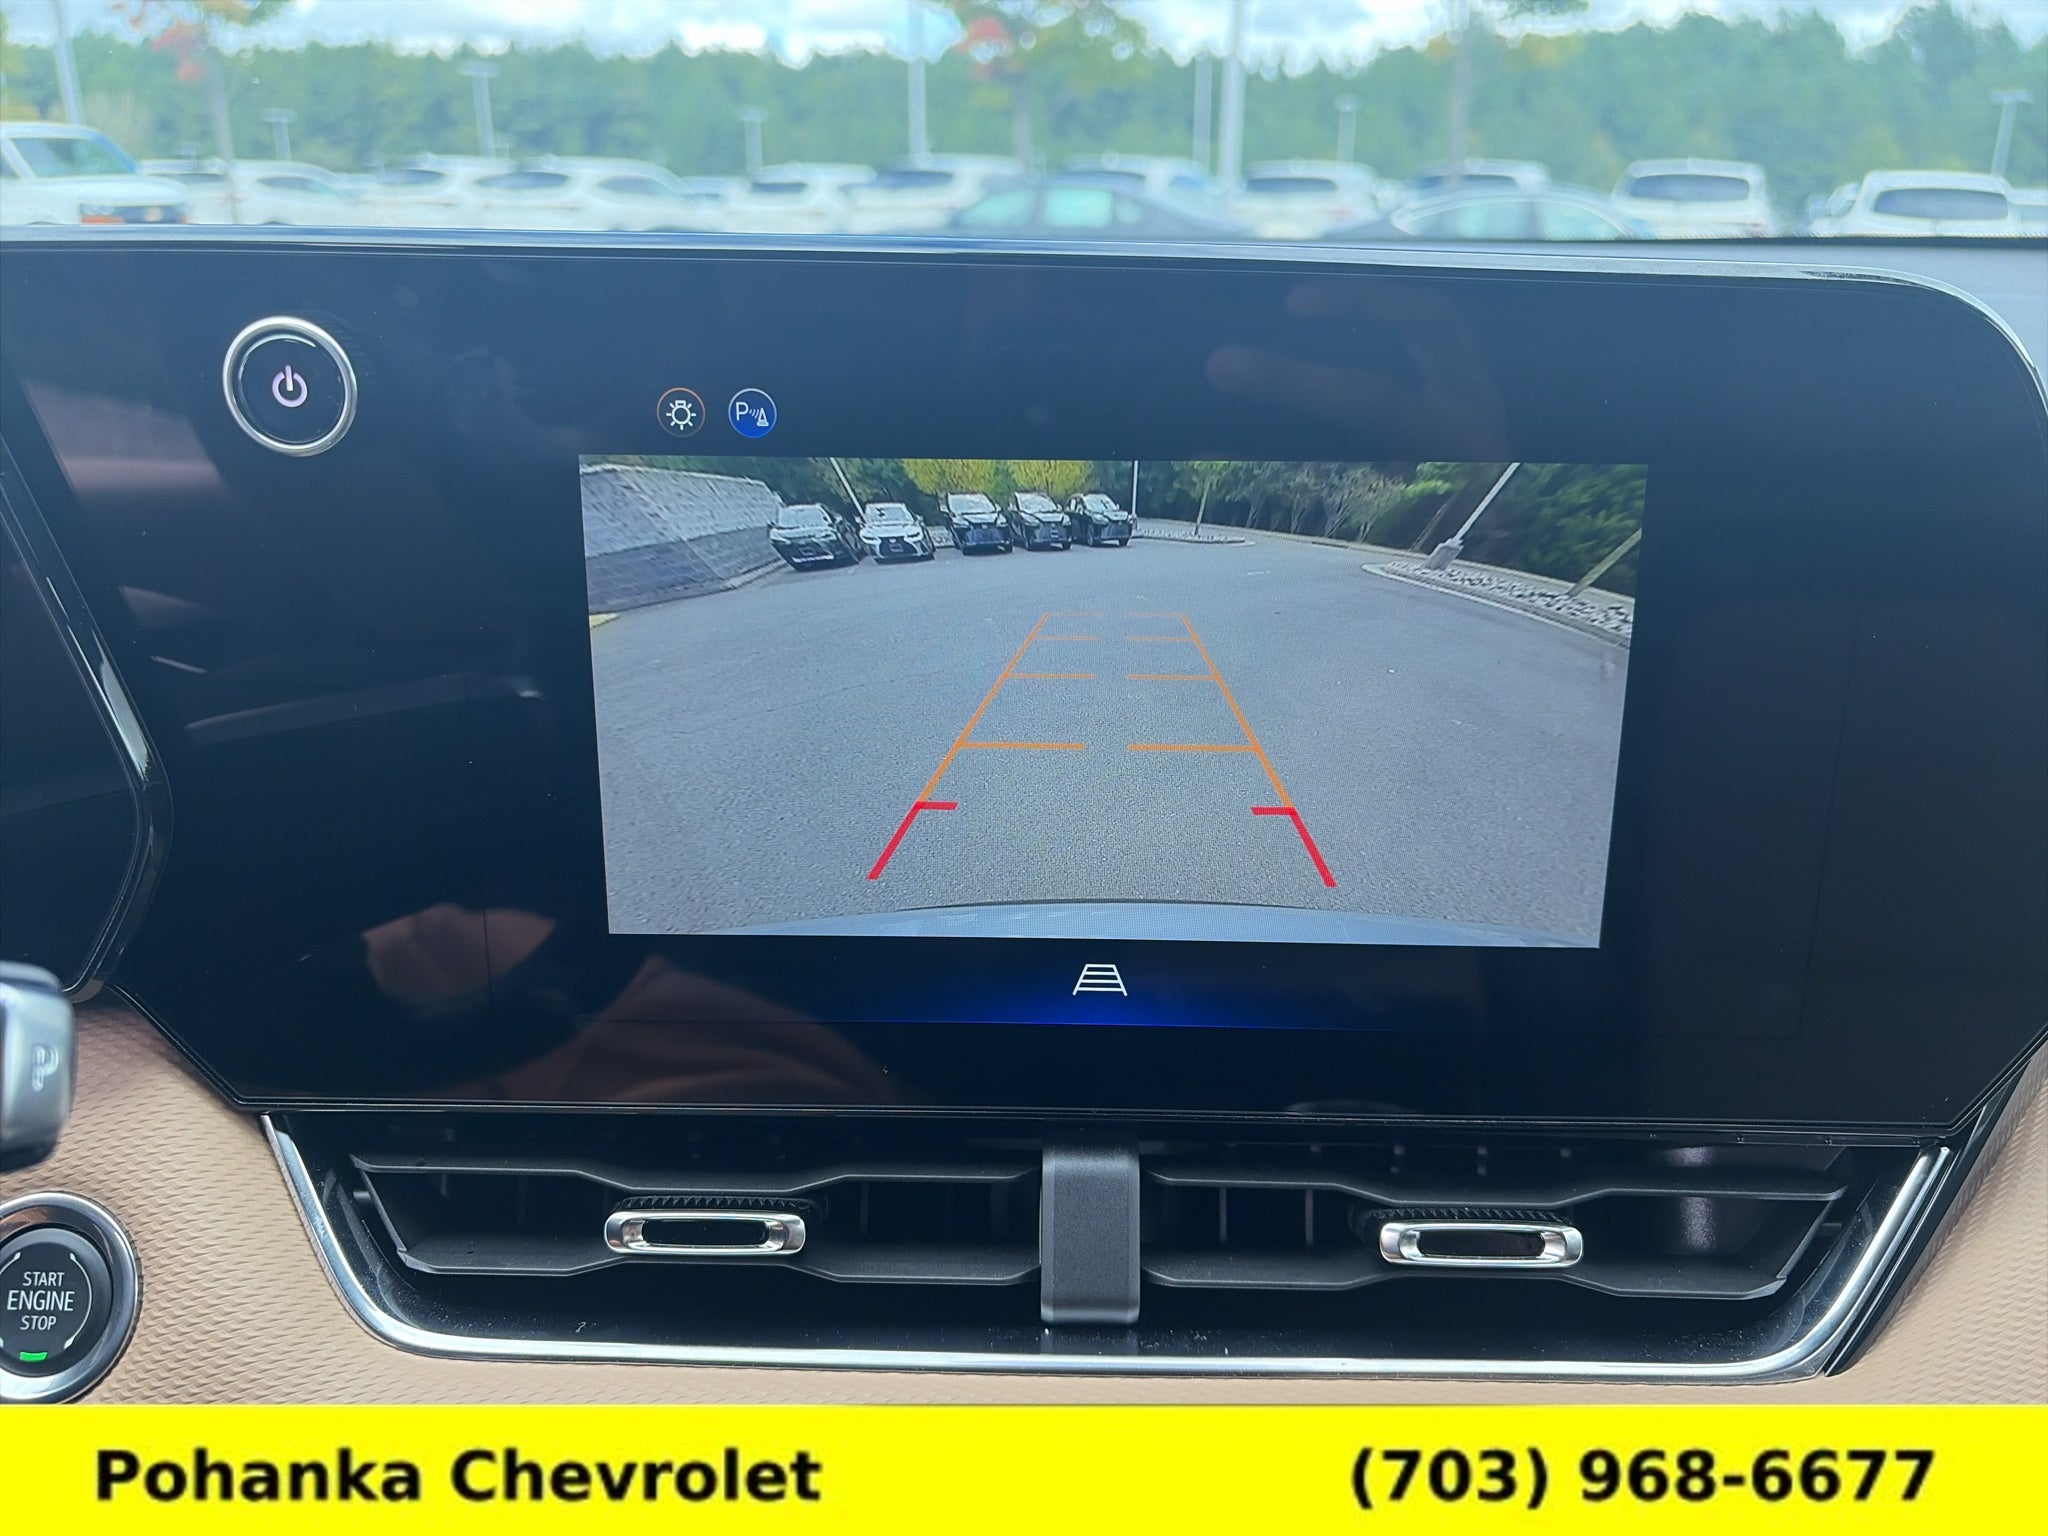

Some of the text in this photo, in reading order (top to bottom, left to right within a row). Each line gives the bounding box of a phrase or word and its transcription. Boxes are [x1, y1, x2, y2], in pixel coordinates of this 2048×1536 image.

[22, 1271, 66, 1287] START
[6, 1289, 76, 1311] ENGINE
[20, 1315, 57, 1331] STOP
